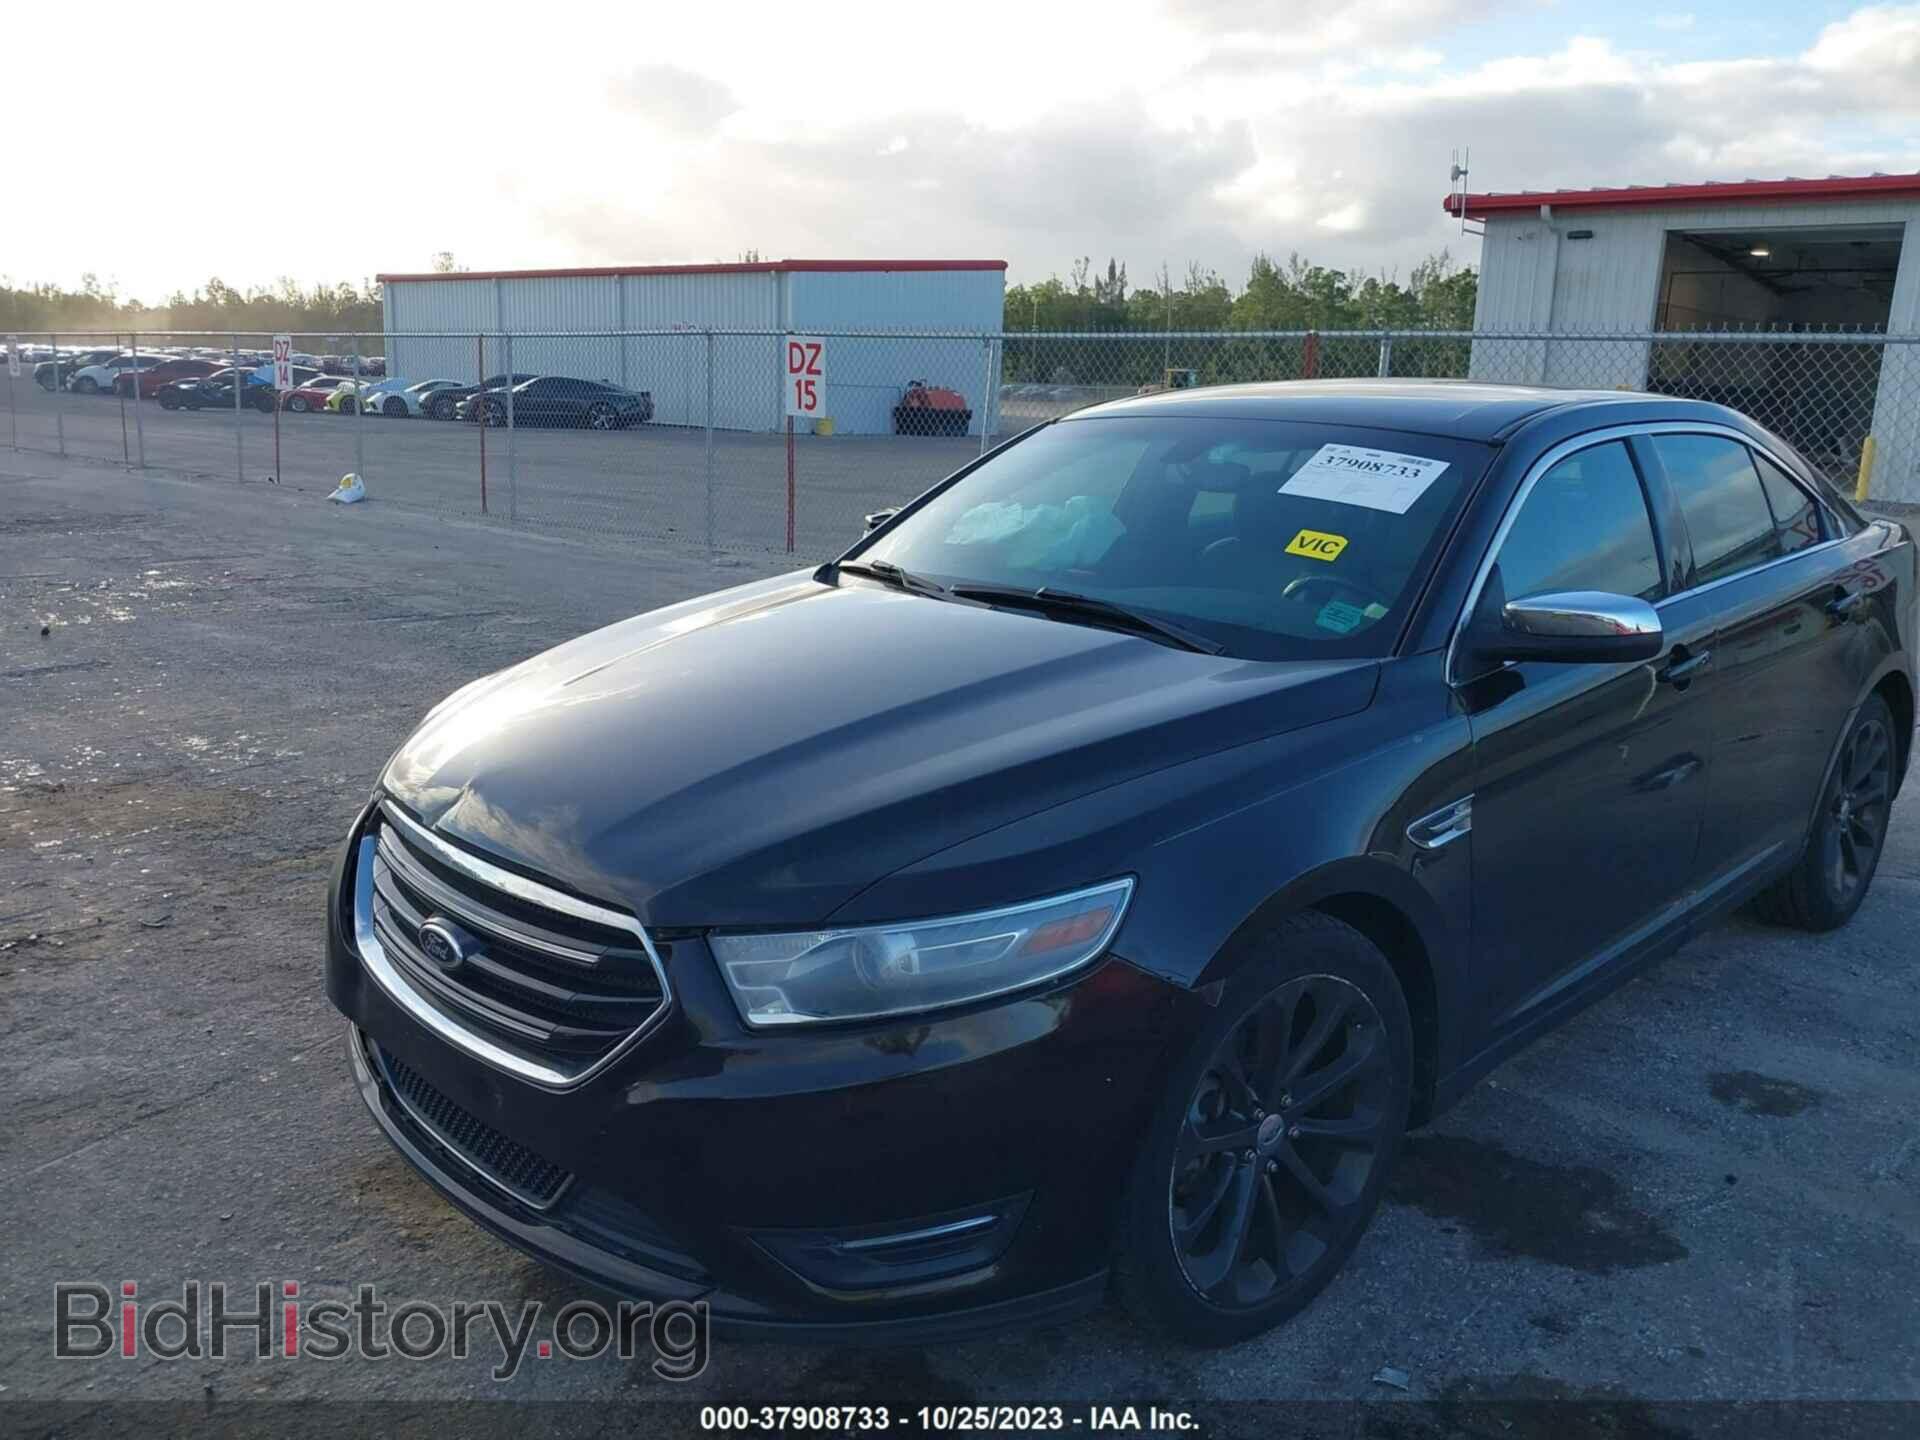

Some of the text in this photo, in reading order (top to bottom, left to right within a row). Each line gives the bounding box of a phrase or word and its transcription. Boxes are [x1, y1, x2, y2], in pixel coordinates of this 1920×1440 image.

[275, 341, 290, 361] DZ
[788, 342, 822, 375] DZ
[279, 365, 289, 386] 14
[795, 379, 817, 411] 15
[1319, 455, 1422, 479] 37908733
[1297, 535, 1340, 555] VIC
